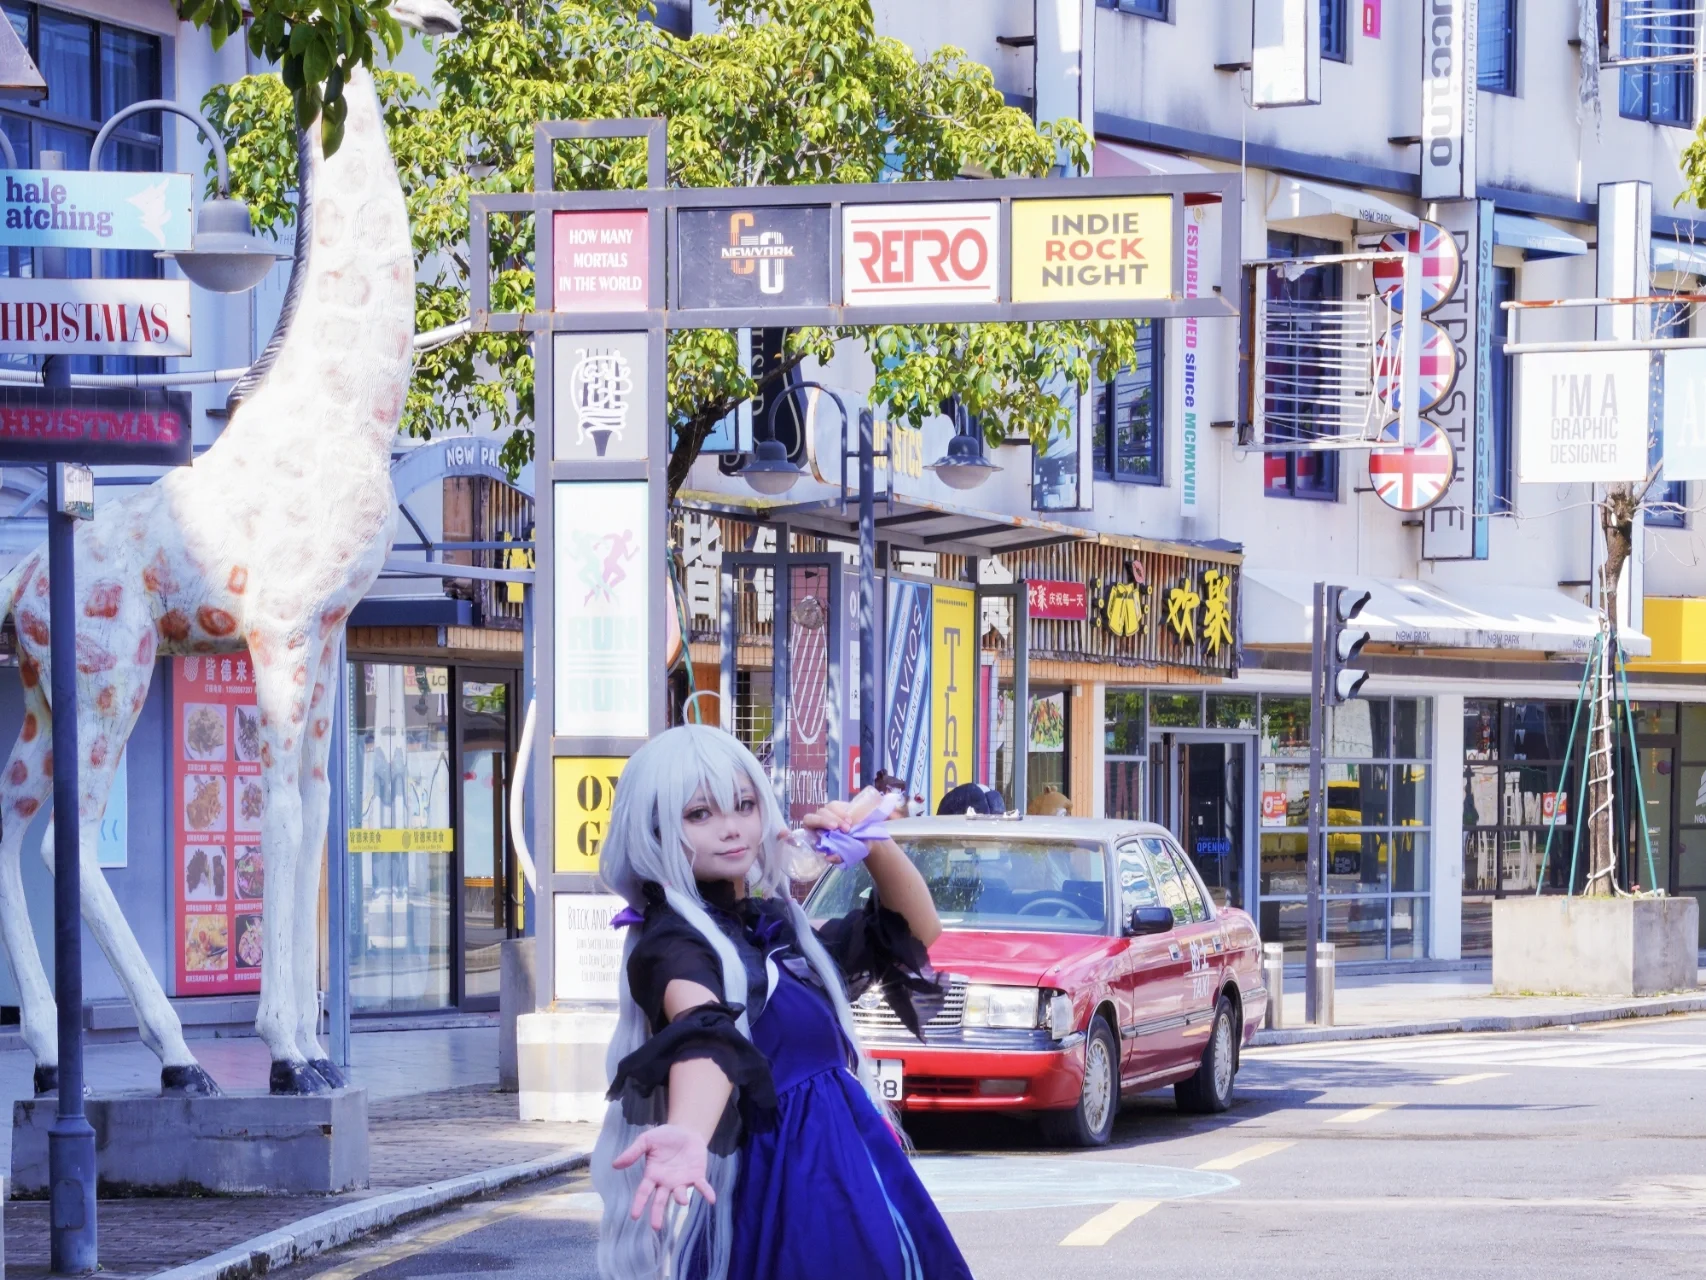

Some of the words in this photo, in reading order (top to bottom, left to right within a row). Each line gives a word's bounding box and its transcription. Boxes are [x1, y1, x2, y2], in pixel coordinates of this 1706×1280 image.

[569, 229, 598, 245] HOW
[600, 228, 633, 245] MANY
[1052, 213, 1139, 236] INDIE
[573, 253, 628, 269] MORTALS
[853, 228, 988, 284] RETRO
[1045, 238, 1146, 262] ROCK
[559, 277, 571, 292] IN
[574, 277, 597, 292] THE
[599, 275, 642, 292] WORLD
[1042, 264, 1149, 287] NIGHT
[1185, 224, 1199, 349] ESTABLIHED
[1184, 353, 1196, 408] since
[1599, 373, 1618, 417] A
[1551, 416, 1619, 441] GRAPHIC
[1551, 443, 1617, 464] DESIGNER
[1166, 569, 1233, 656] 欢聚
[567, 616, 639, 650] RUN
[567, 678, 639, 712] RUN
[1196, 842, 1231, 853] OPENING
[1192, 973, 1210, 1000] TAXI
